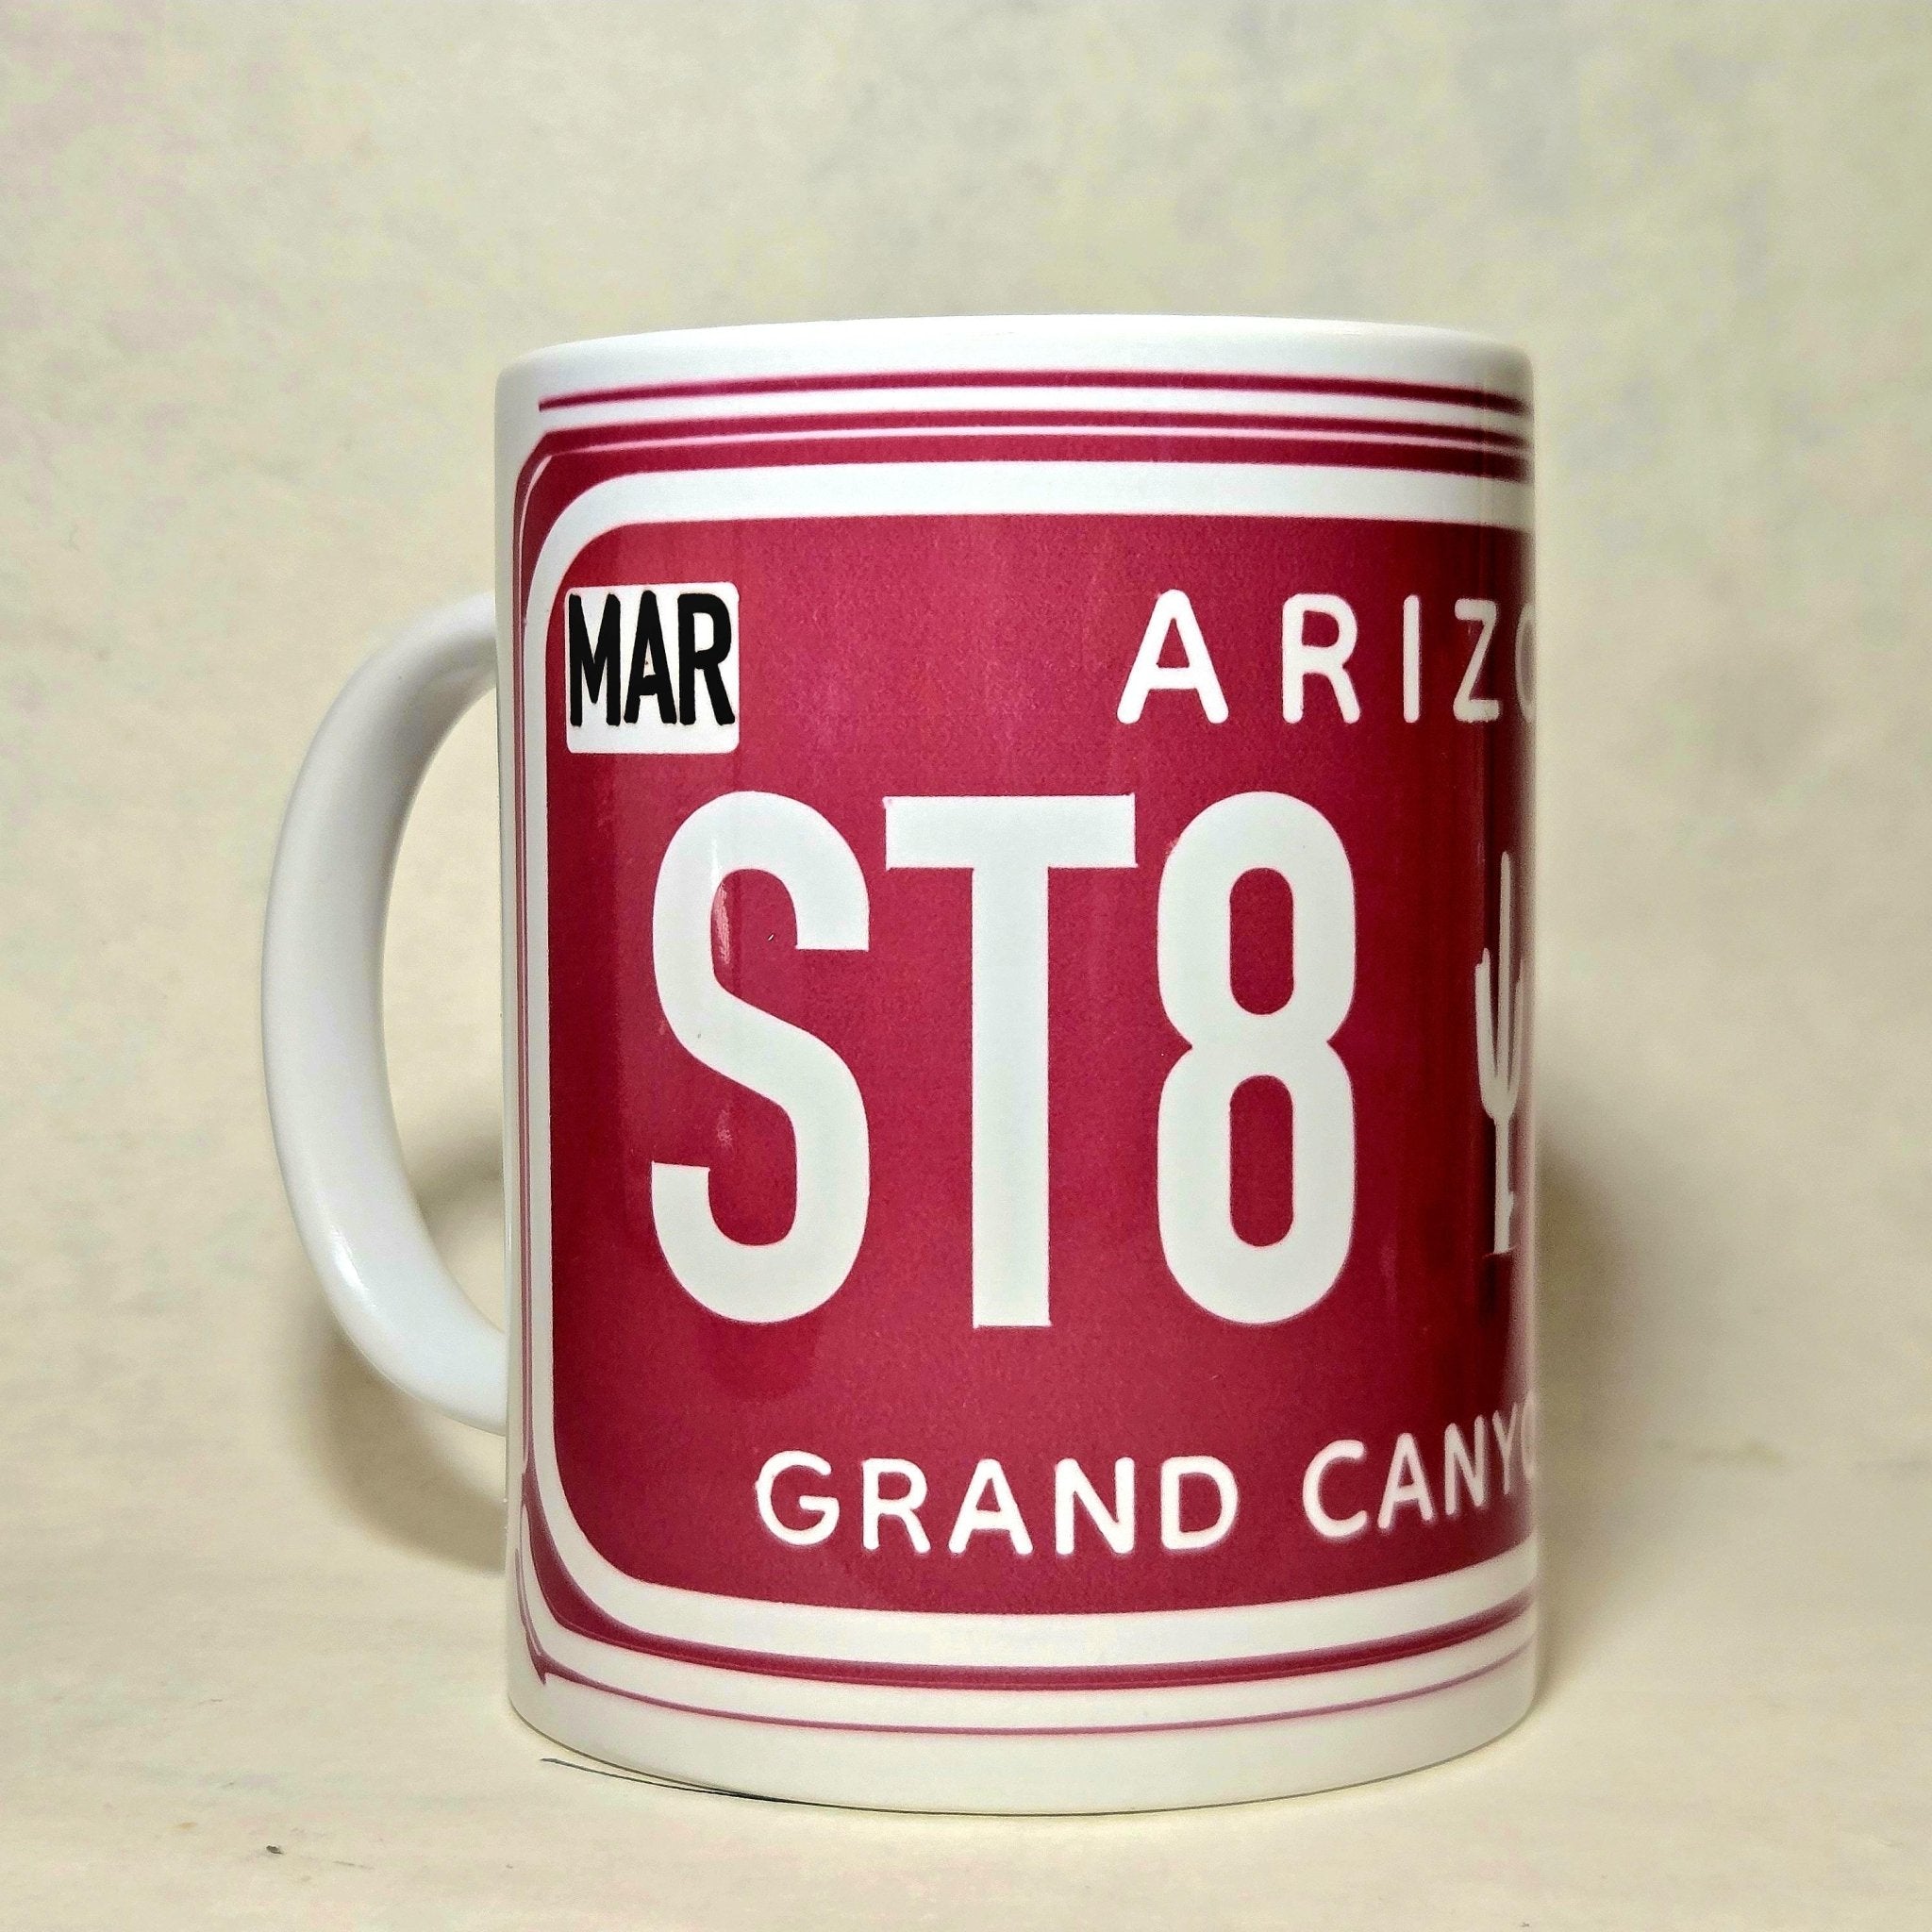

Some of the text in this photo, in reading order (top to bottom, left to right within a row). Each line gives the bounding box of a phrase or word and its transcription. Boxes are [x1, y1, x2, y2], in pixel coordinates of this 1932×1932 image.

[568, 590, 736, 726] MAR
[651, 791, 1357, 1329] ST8
[756, 1449, 1239, 1555] GRAND
